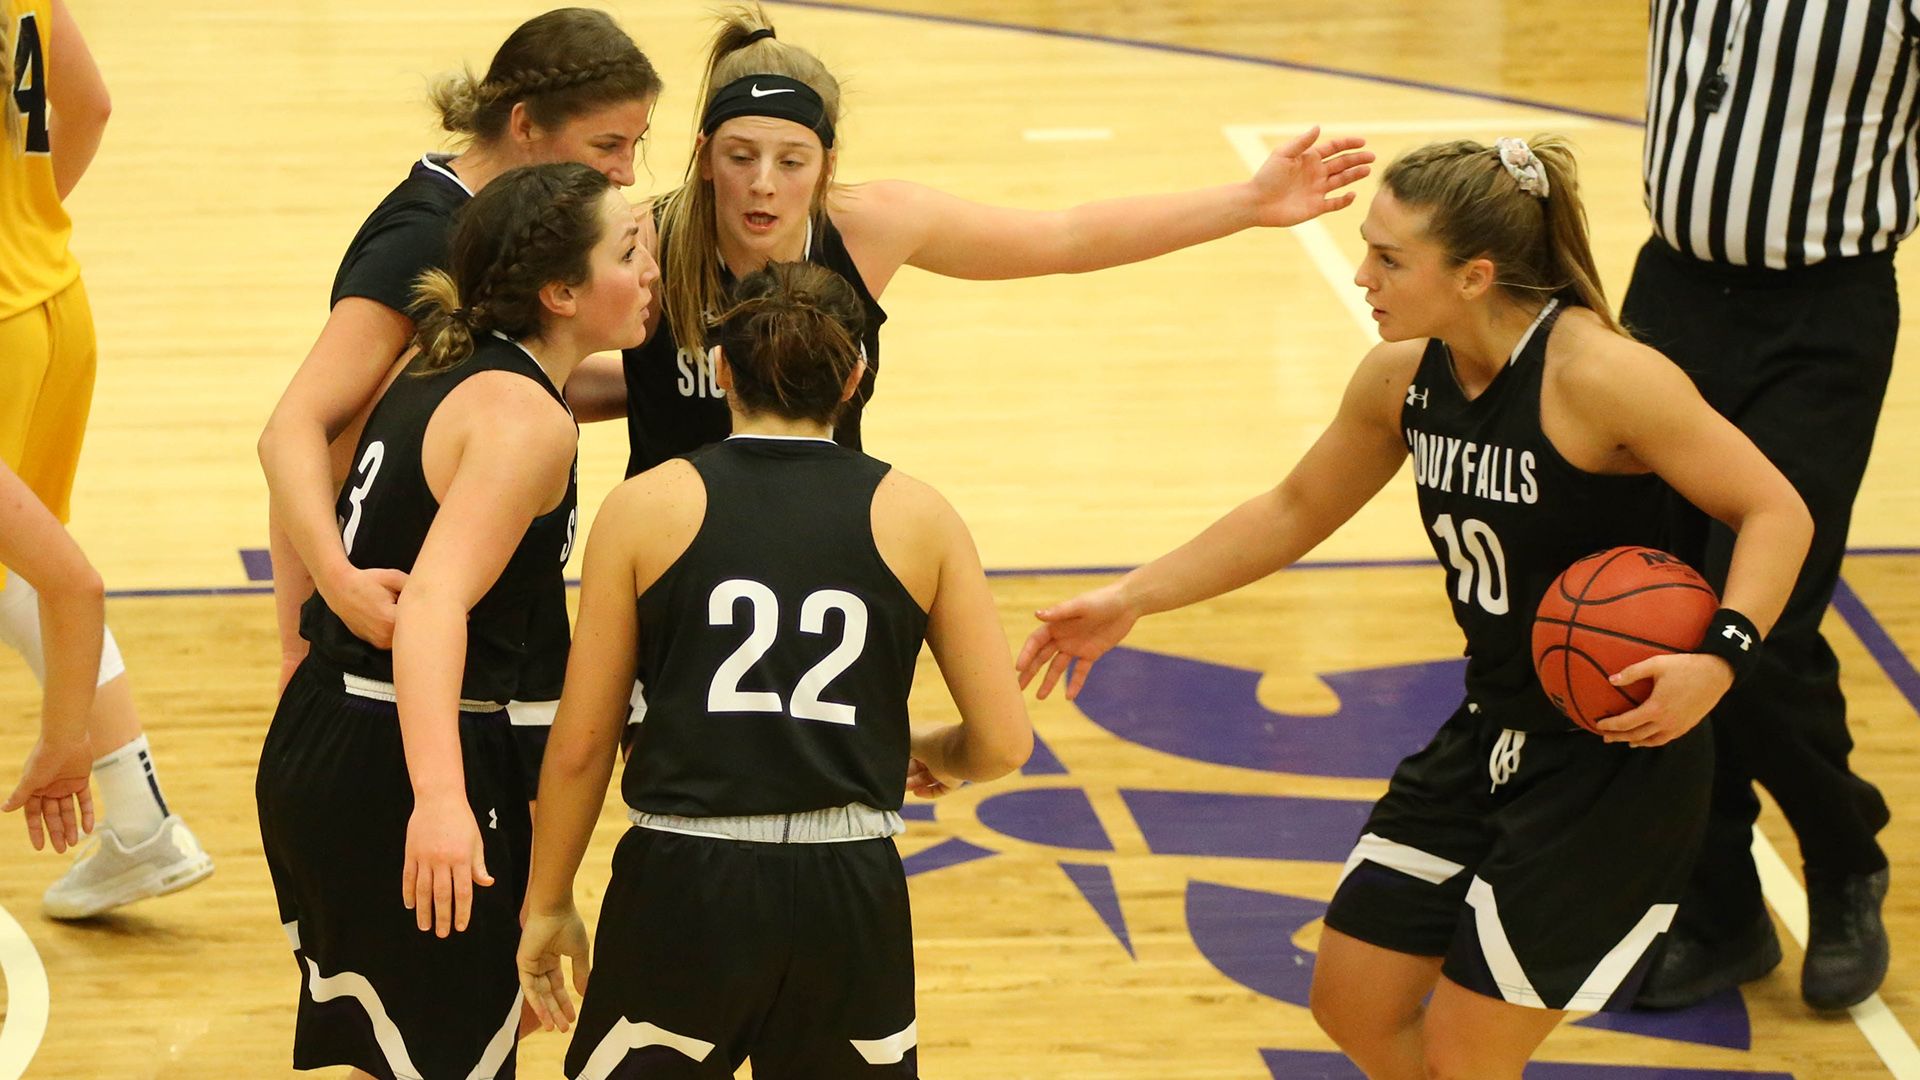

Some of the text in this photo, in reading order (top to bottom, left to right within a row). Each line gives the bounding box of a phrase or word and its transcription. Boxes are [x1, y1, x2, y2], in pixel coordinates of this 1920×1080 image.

[1406, 427, 1539, 505] IOUX FALLS
[1432, 513, 1510, 616] 10
[707, 578, 869, 727] 22
